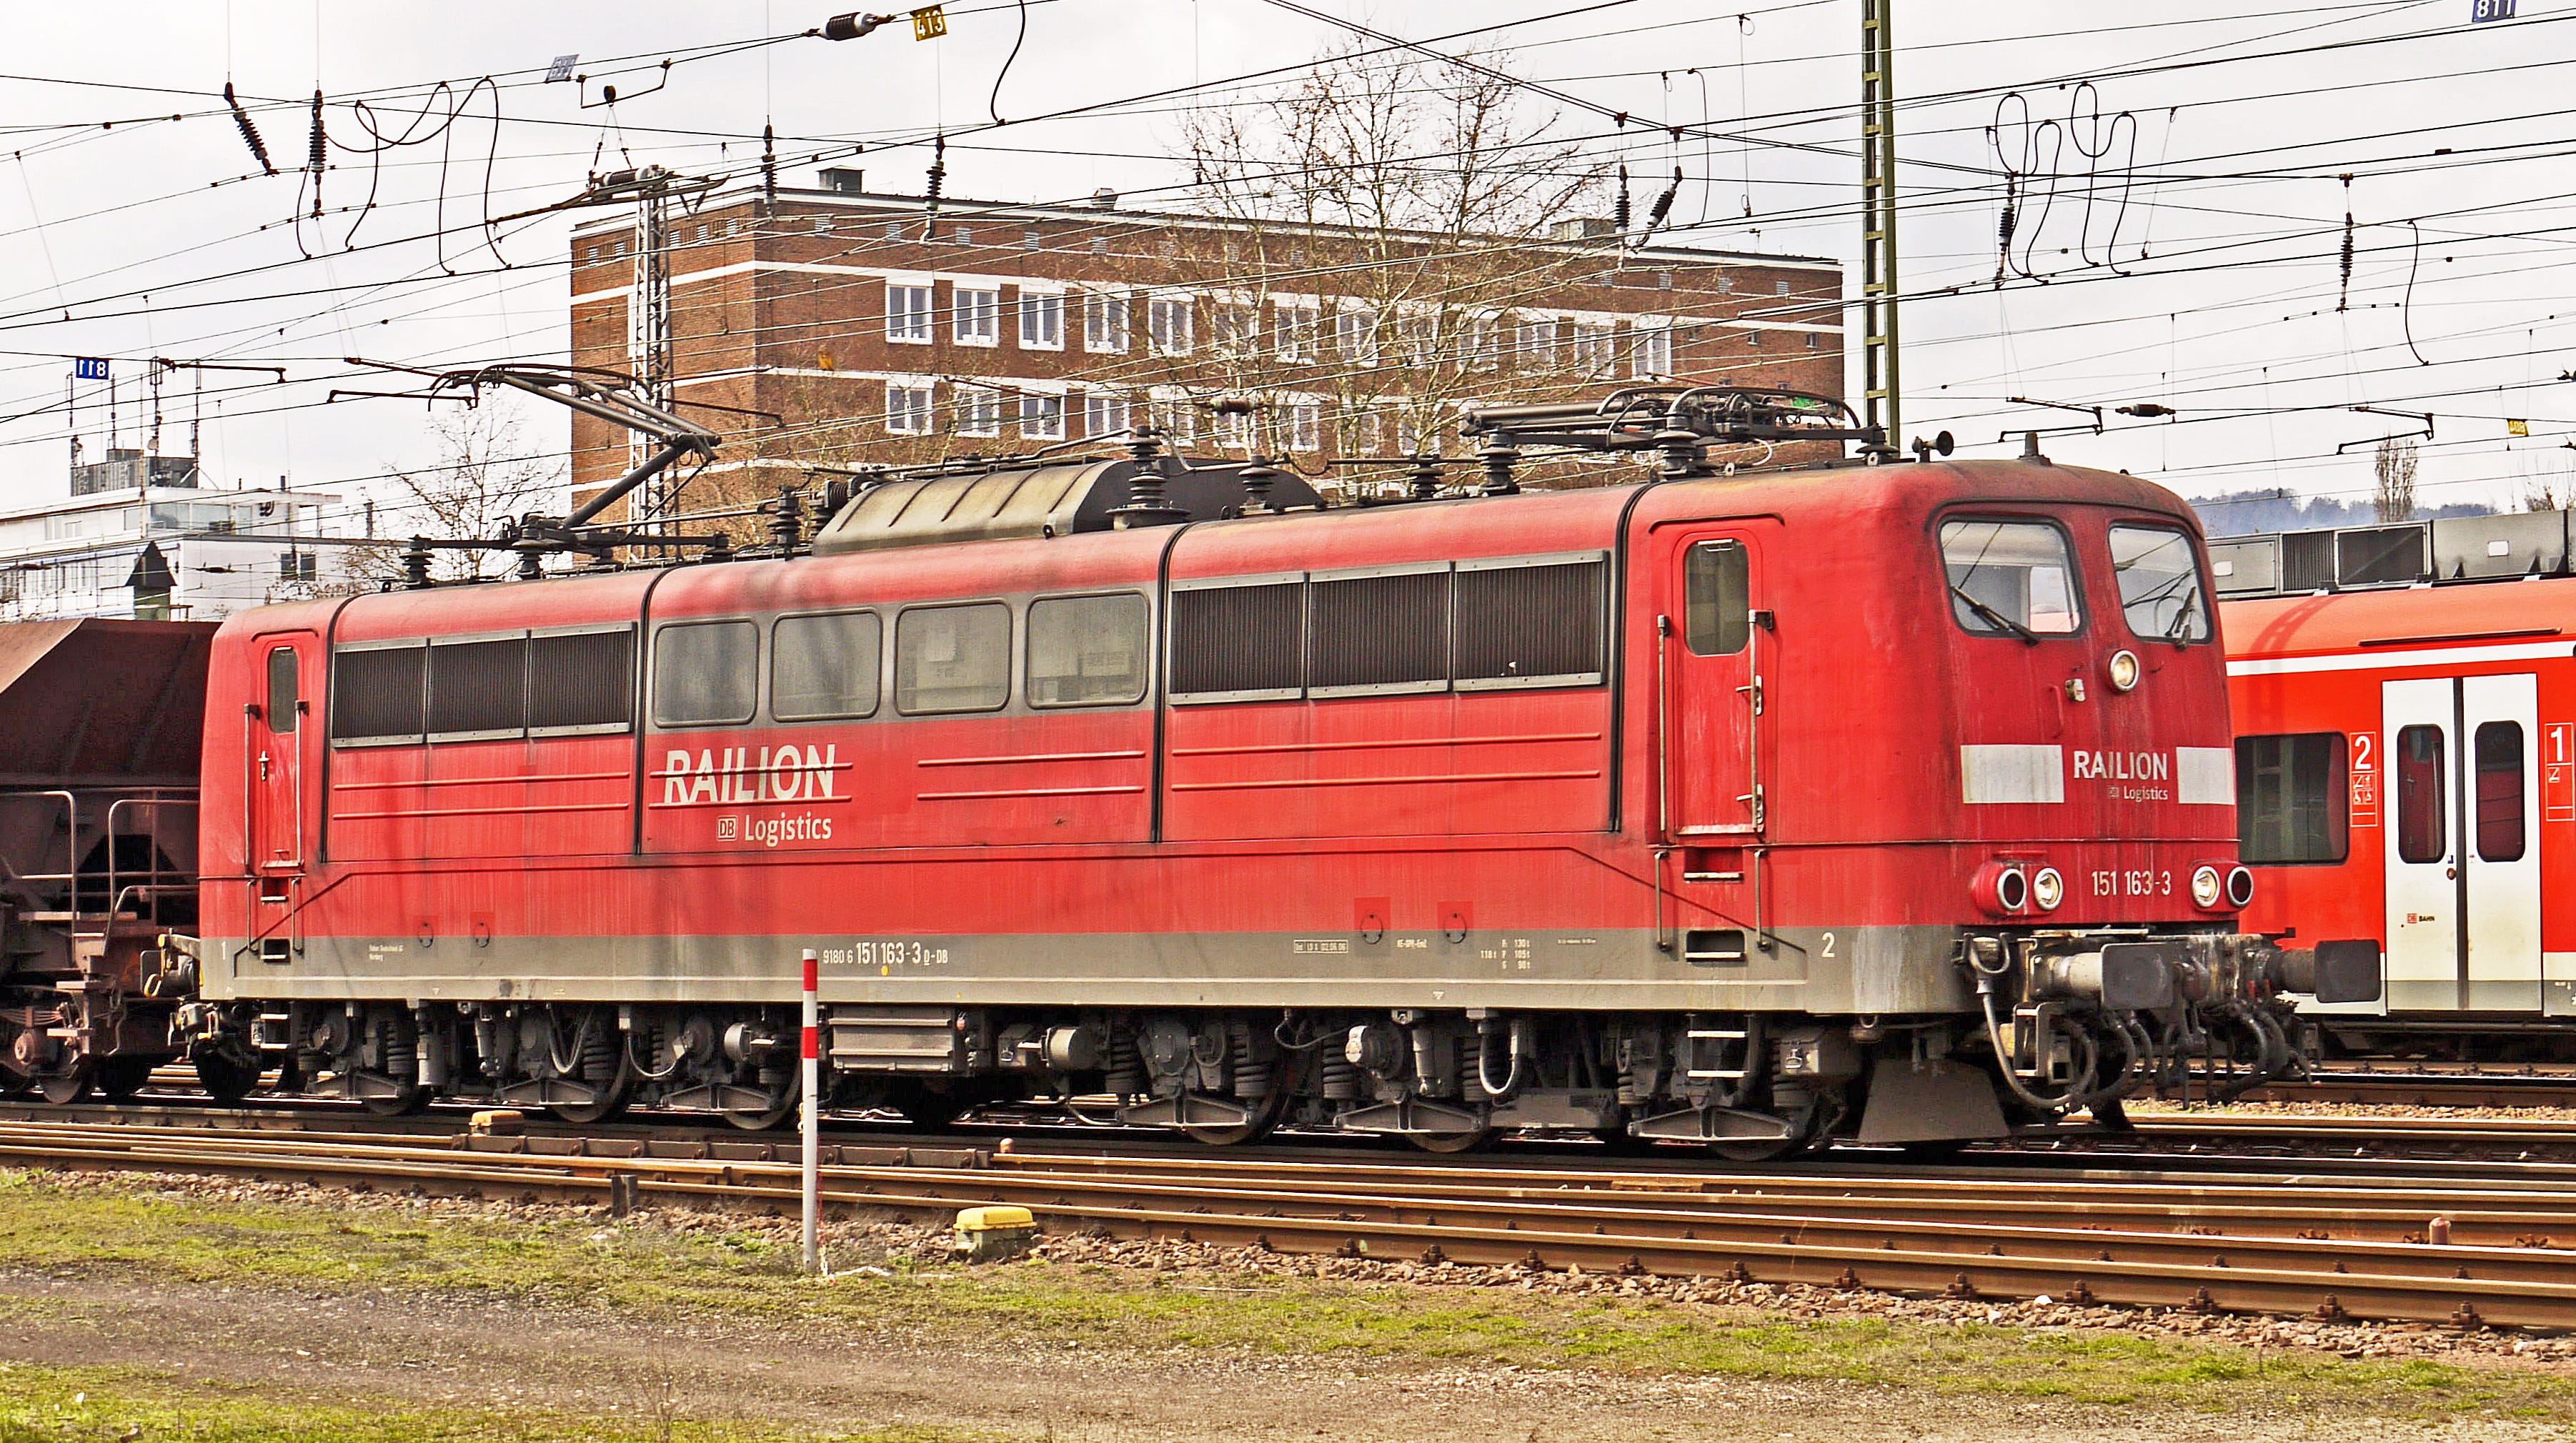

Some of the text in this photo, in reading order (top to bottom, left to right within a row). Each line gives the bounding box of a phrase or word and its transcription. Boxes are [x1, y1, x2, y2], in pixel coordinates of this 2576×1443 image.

[2477, 0, 2512, 18] 811
[2354, 735, 2372, 770] 2
[2550, 727, 2563, 762] 1
[664, 744, 835, 804] RAILION
[2074, 750, 2168, 781] RAILION
[2124, 785, 2169, 803] Logistics
[719, 812, 832, 847] DB Logistics
[2092, 870, 2171, 896] 151 163-3
[823, 950, 845, 964] 9180
[847, 951, 853, 964] 6
[856, 942, 877, 964] 151
[880, 942, 920, 964] 163-3
[1822, 932, 1835, 958] 2
